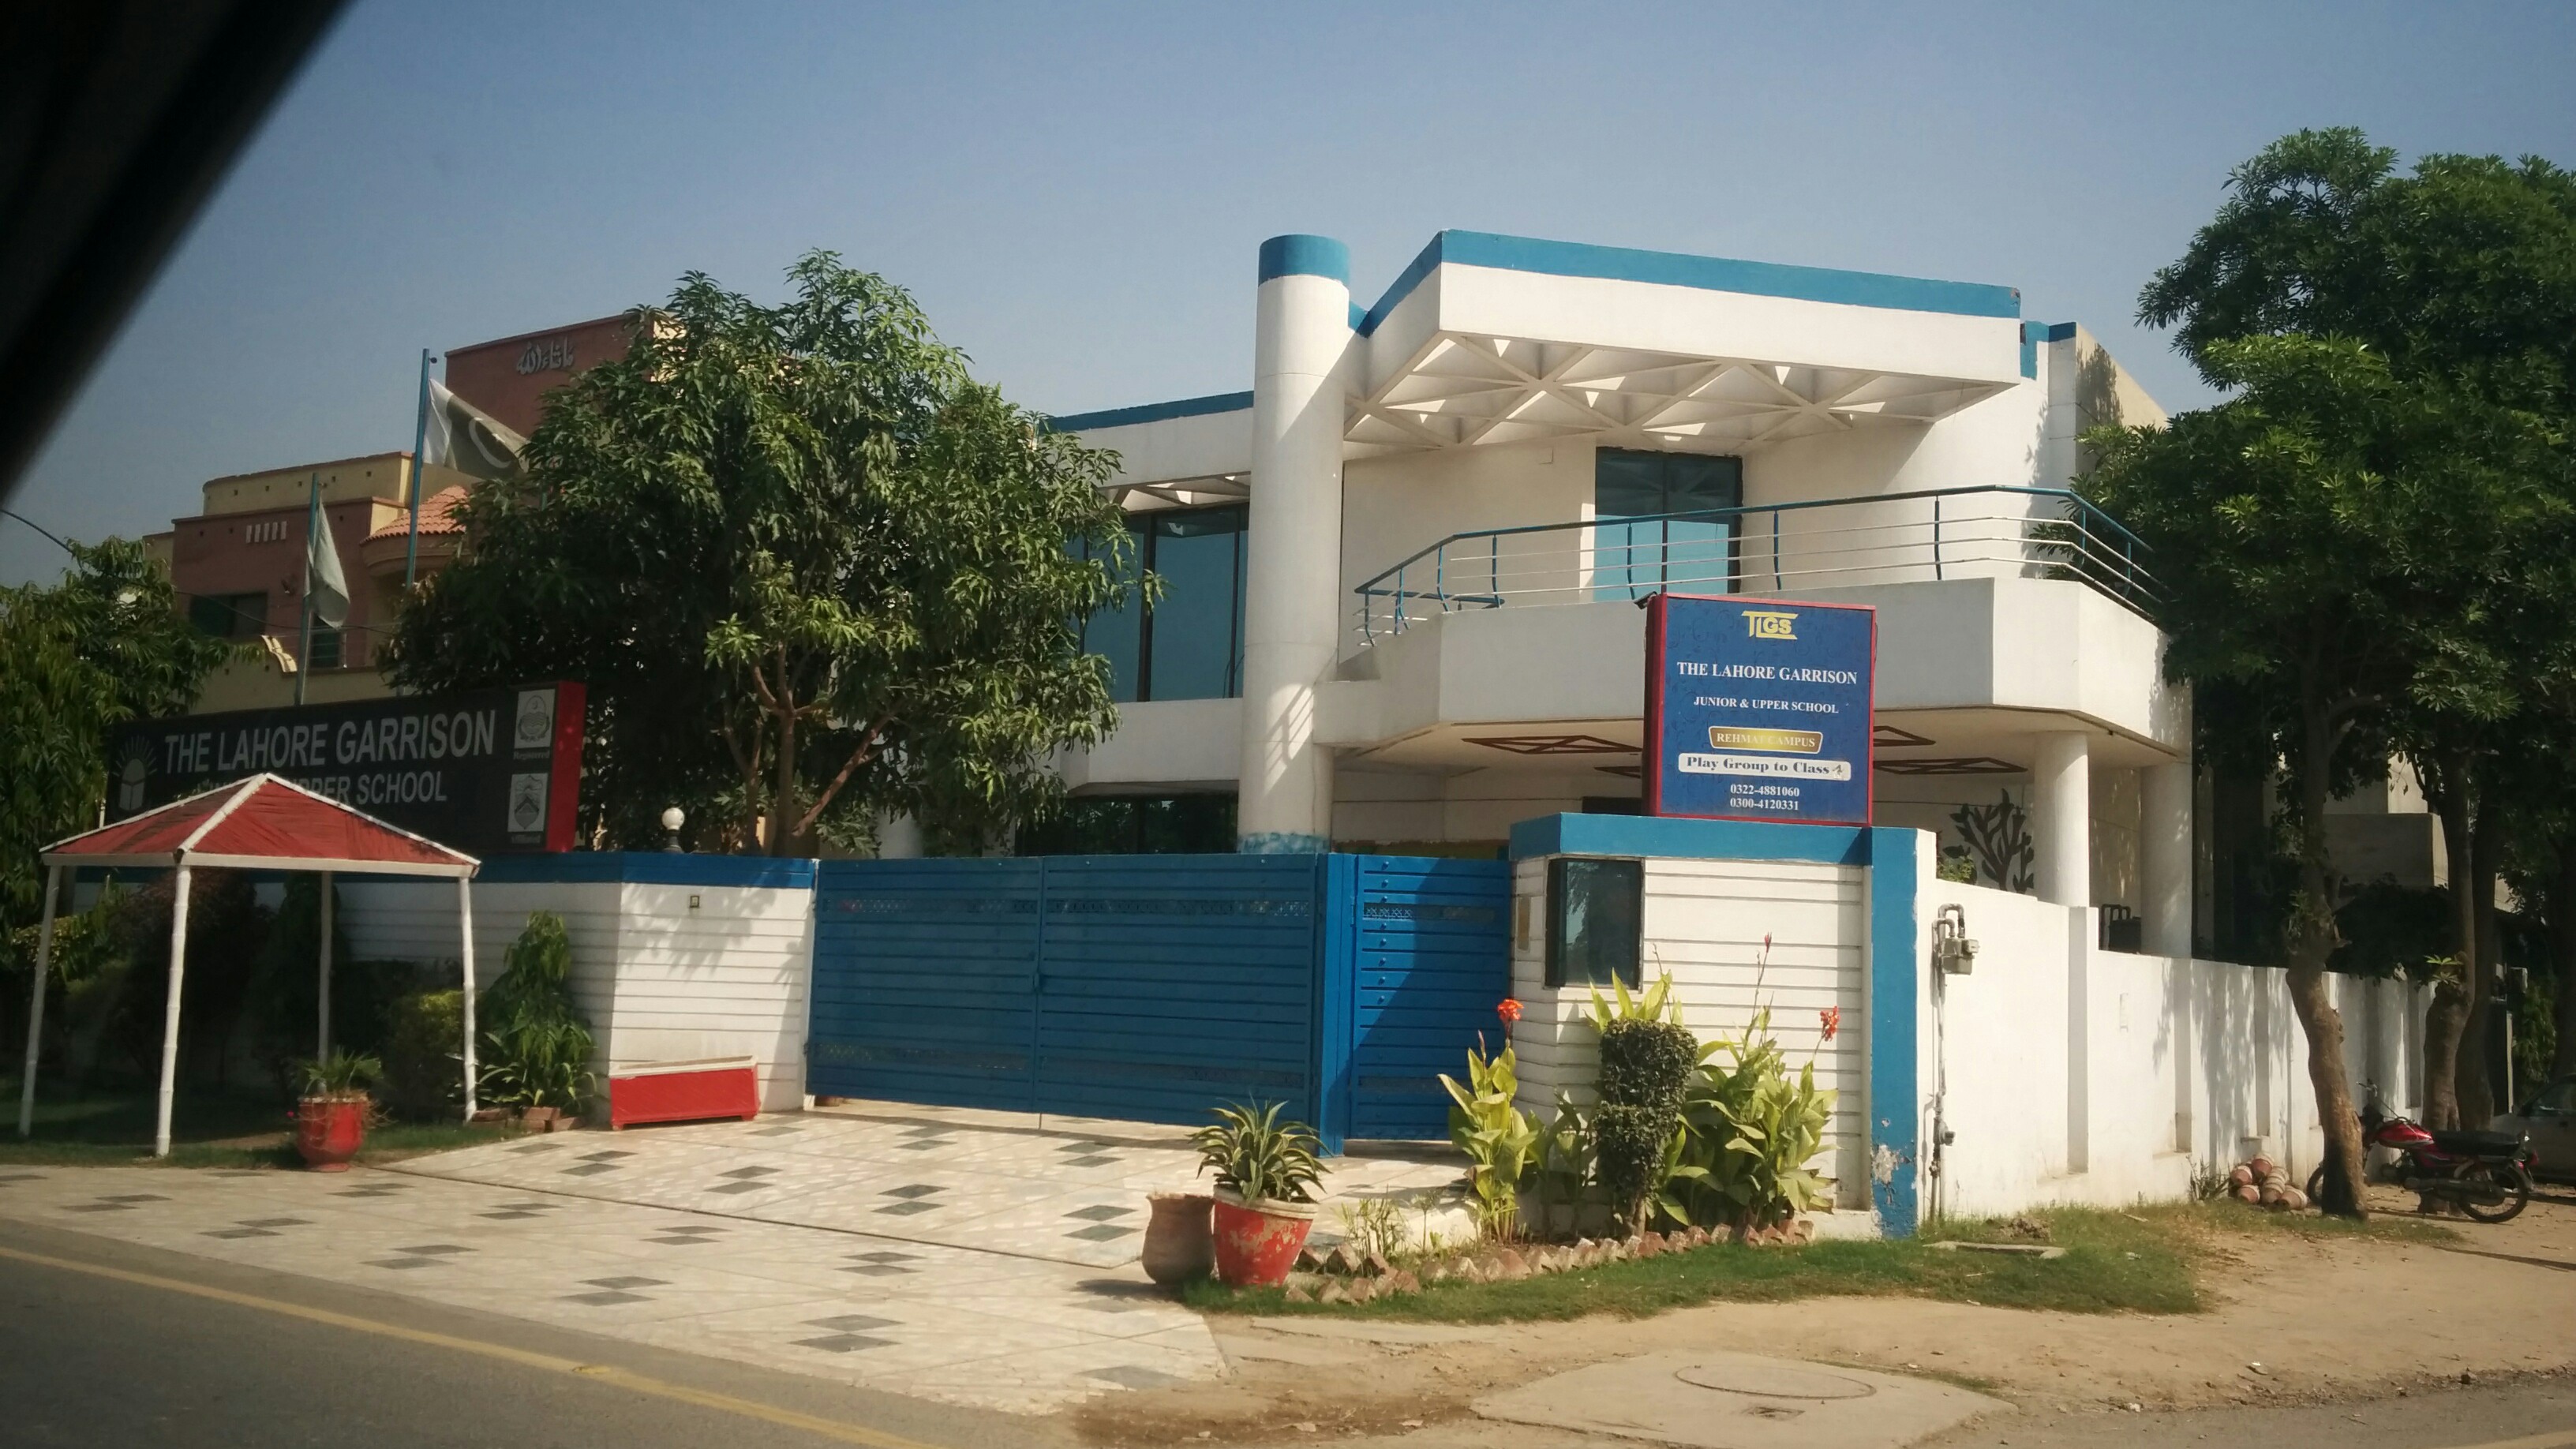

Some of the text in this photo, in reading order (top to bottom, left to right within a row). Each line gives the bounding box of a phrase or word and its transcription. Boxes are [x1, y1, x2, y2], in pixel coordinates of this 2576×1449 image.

[1741, 610, 1799, 640] TLGS
[1677, 661, 1858, 684] THE LAHORE GARRISON
[1694, 696, 1839, 713] JUNIOR & UPPER SCHOOL
[164, 710, 496, 773] THE LAHORE GARRISON
[1717, 732, 1816, 747] REHMAT CAMPUS
[1687, 756, 1719, 770] Play
[1723, 758, 1769, 773] Group
[1774, 762, 1788, 773] to
[1793, 762, 1829, 775] Class
[356, 770, 447, 806] SCHOOL
[1730, 784, 1800, 797] 0322-4881060
[1729, 797, 1799, 811] 0300-4120331
